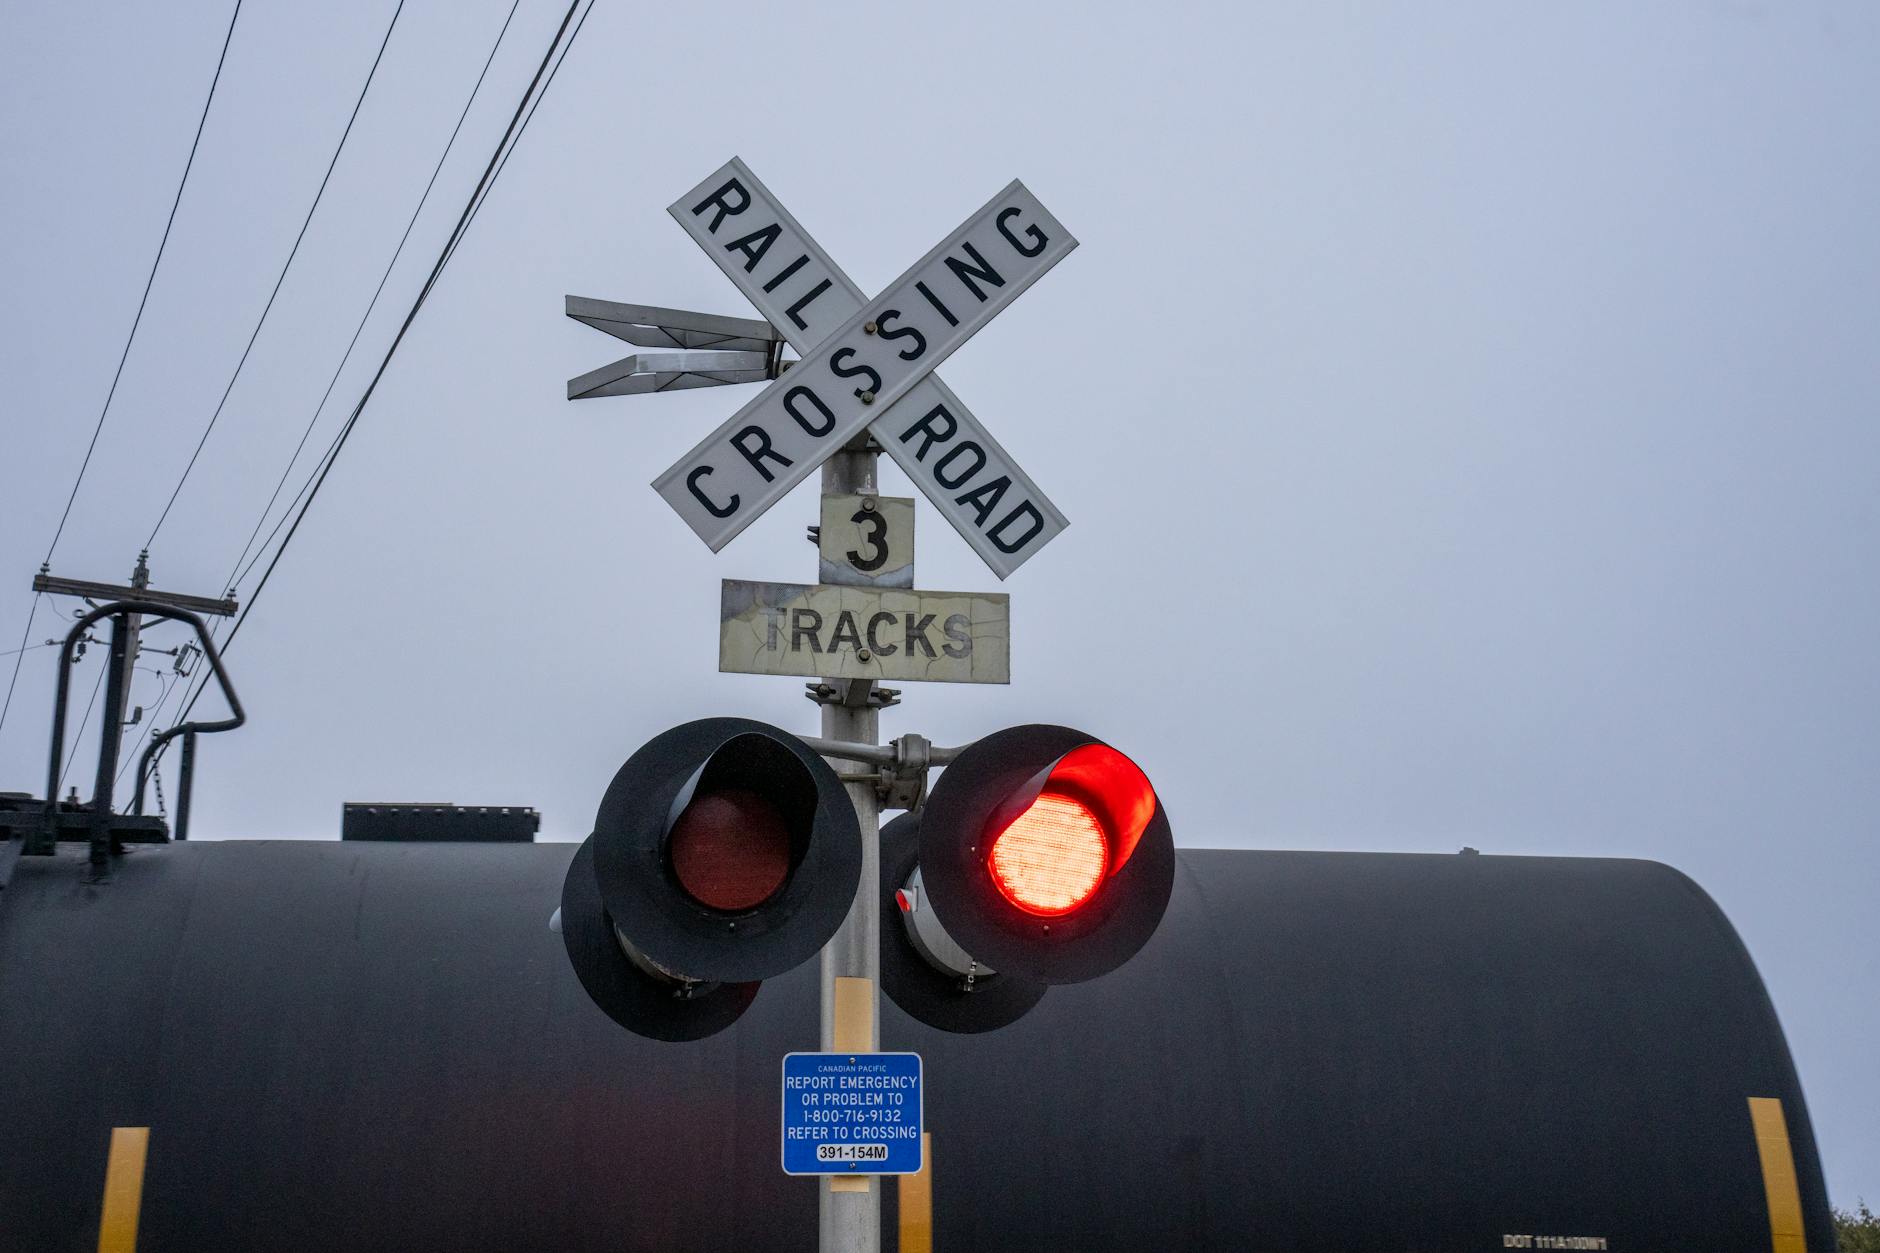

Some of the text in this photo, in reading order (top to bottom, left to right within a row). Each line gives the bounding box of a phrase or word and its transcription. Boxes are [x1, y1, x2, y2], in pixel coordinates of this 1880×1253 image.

[687, 207, 1049, 518] CROSSING
[692, 178, 1044, 554] RAIL ROAD
[847, 510, 889, 571] 3
[759, 607, 973, 659] TRACKS
[818, 1065, 887, 1073] CANADIAN PACIFIC
[787, 1076, 917, 1089] REPORT EMERGENCY
[802, 1093, 903, 1105] OR PROBLEM TO
[804, 1110, 901, 1122] 1-800-716-9132
[788, 1126, 917, 1139] REFER TO CROSSING
[819, 1146, 886, 1159] 391-154M
[1503, 1234, 1533, 1249] DOT
